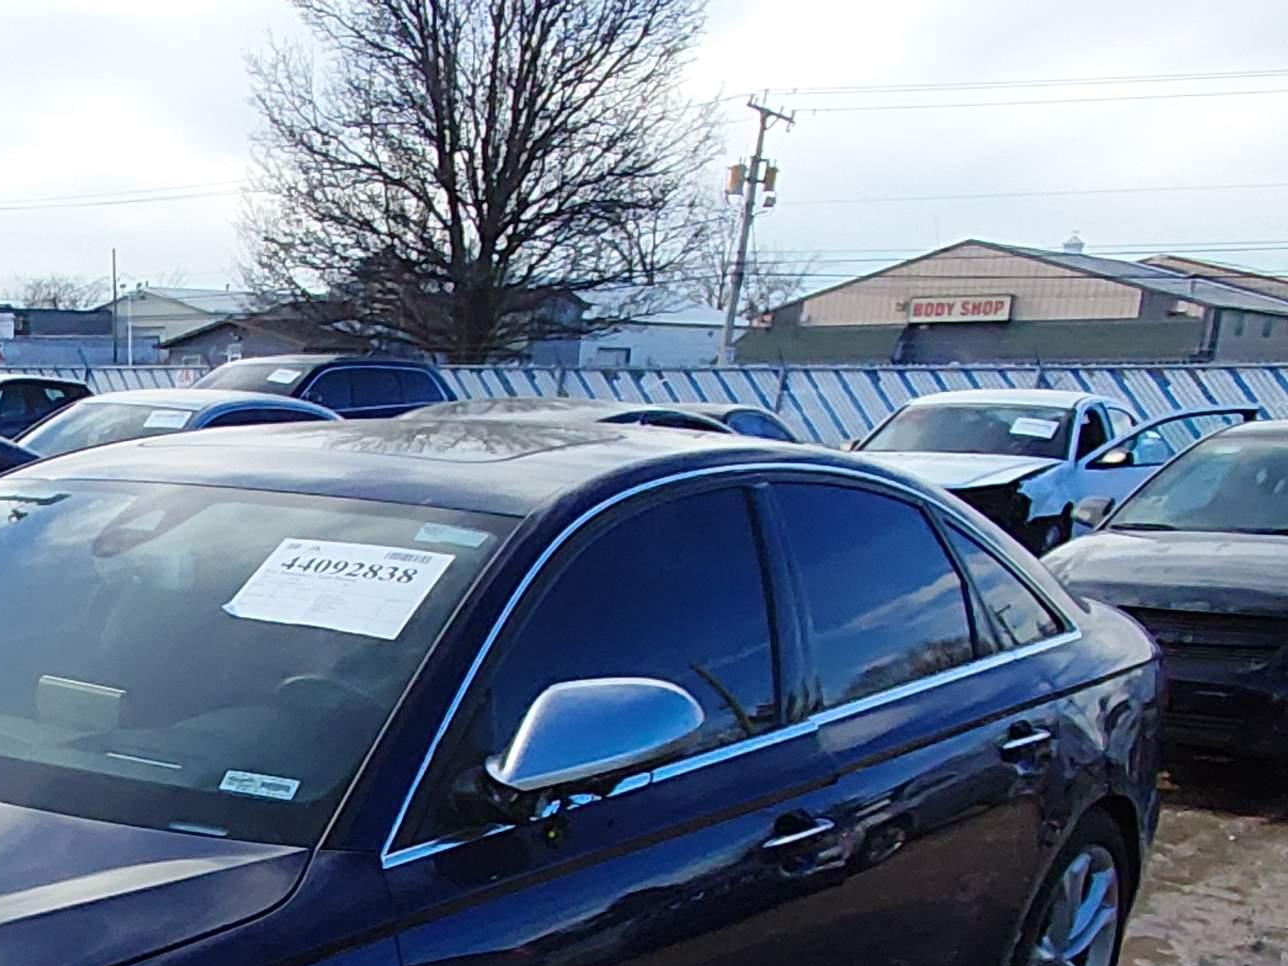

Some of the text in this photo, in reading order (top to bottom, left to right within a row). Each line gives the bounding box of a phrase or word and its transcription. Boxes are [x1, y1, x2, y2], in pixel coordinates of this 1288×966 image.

[912, 300, 1005, 317] BODY SHOP
[281, 556, 418, 584] 44092838
